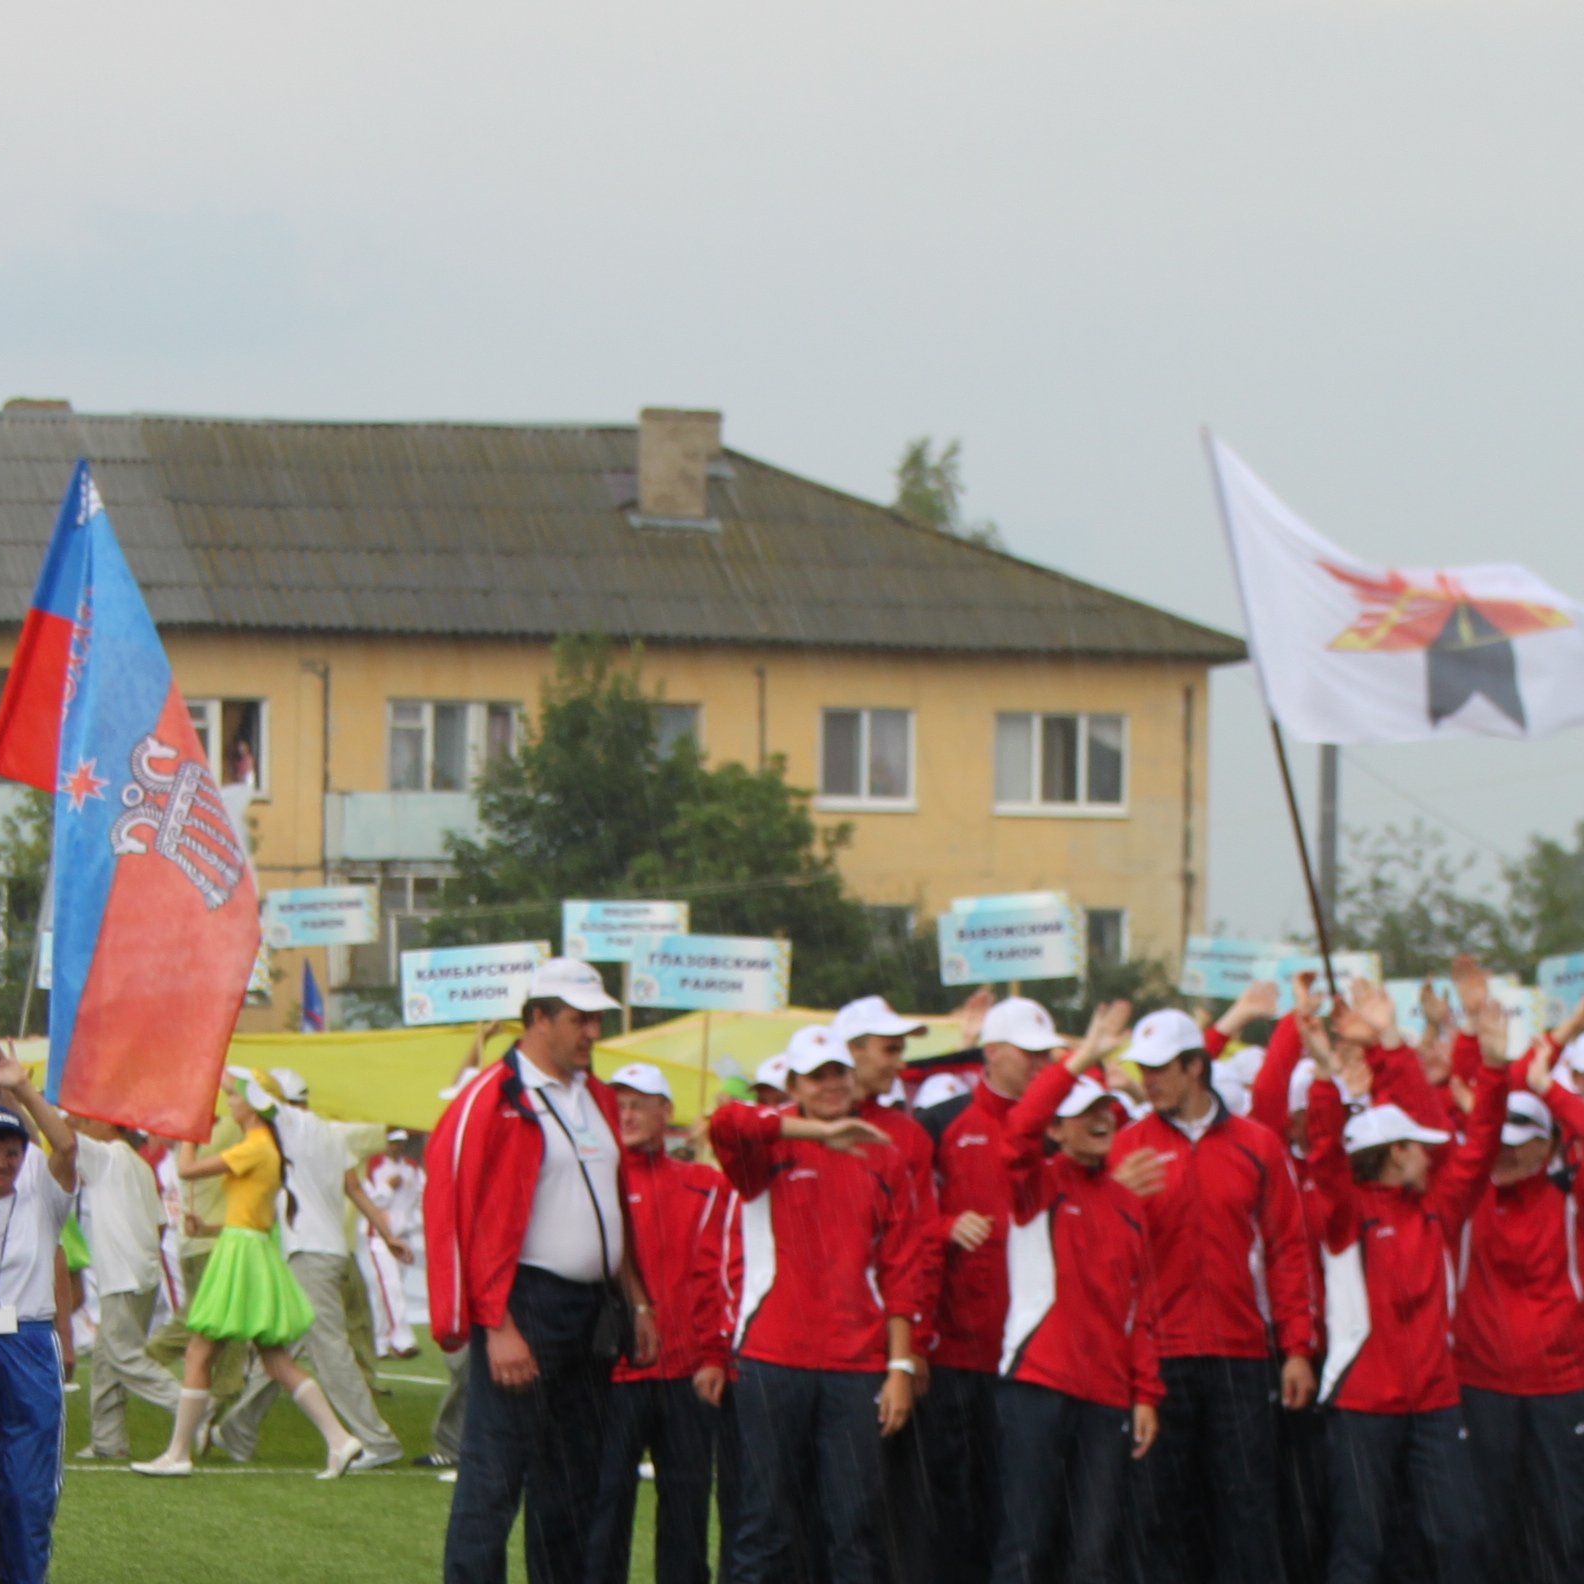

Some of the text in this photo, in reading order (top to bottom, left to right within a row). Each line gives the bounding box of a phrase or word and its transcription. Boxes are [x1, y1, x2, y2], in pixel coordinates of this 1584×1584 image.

[648, 951, 772, 970] ГЛАЗОВСКИЙ
[984, 945, 1044, 961] РАЙОН
[416, 961, 534, 982] КАМБАРСКИЙ
[680, 975, 744, 992] РАЙОН
[449, 985, 508, 1001] РАЙОН
